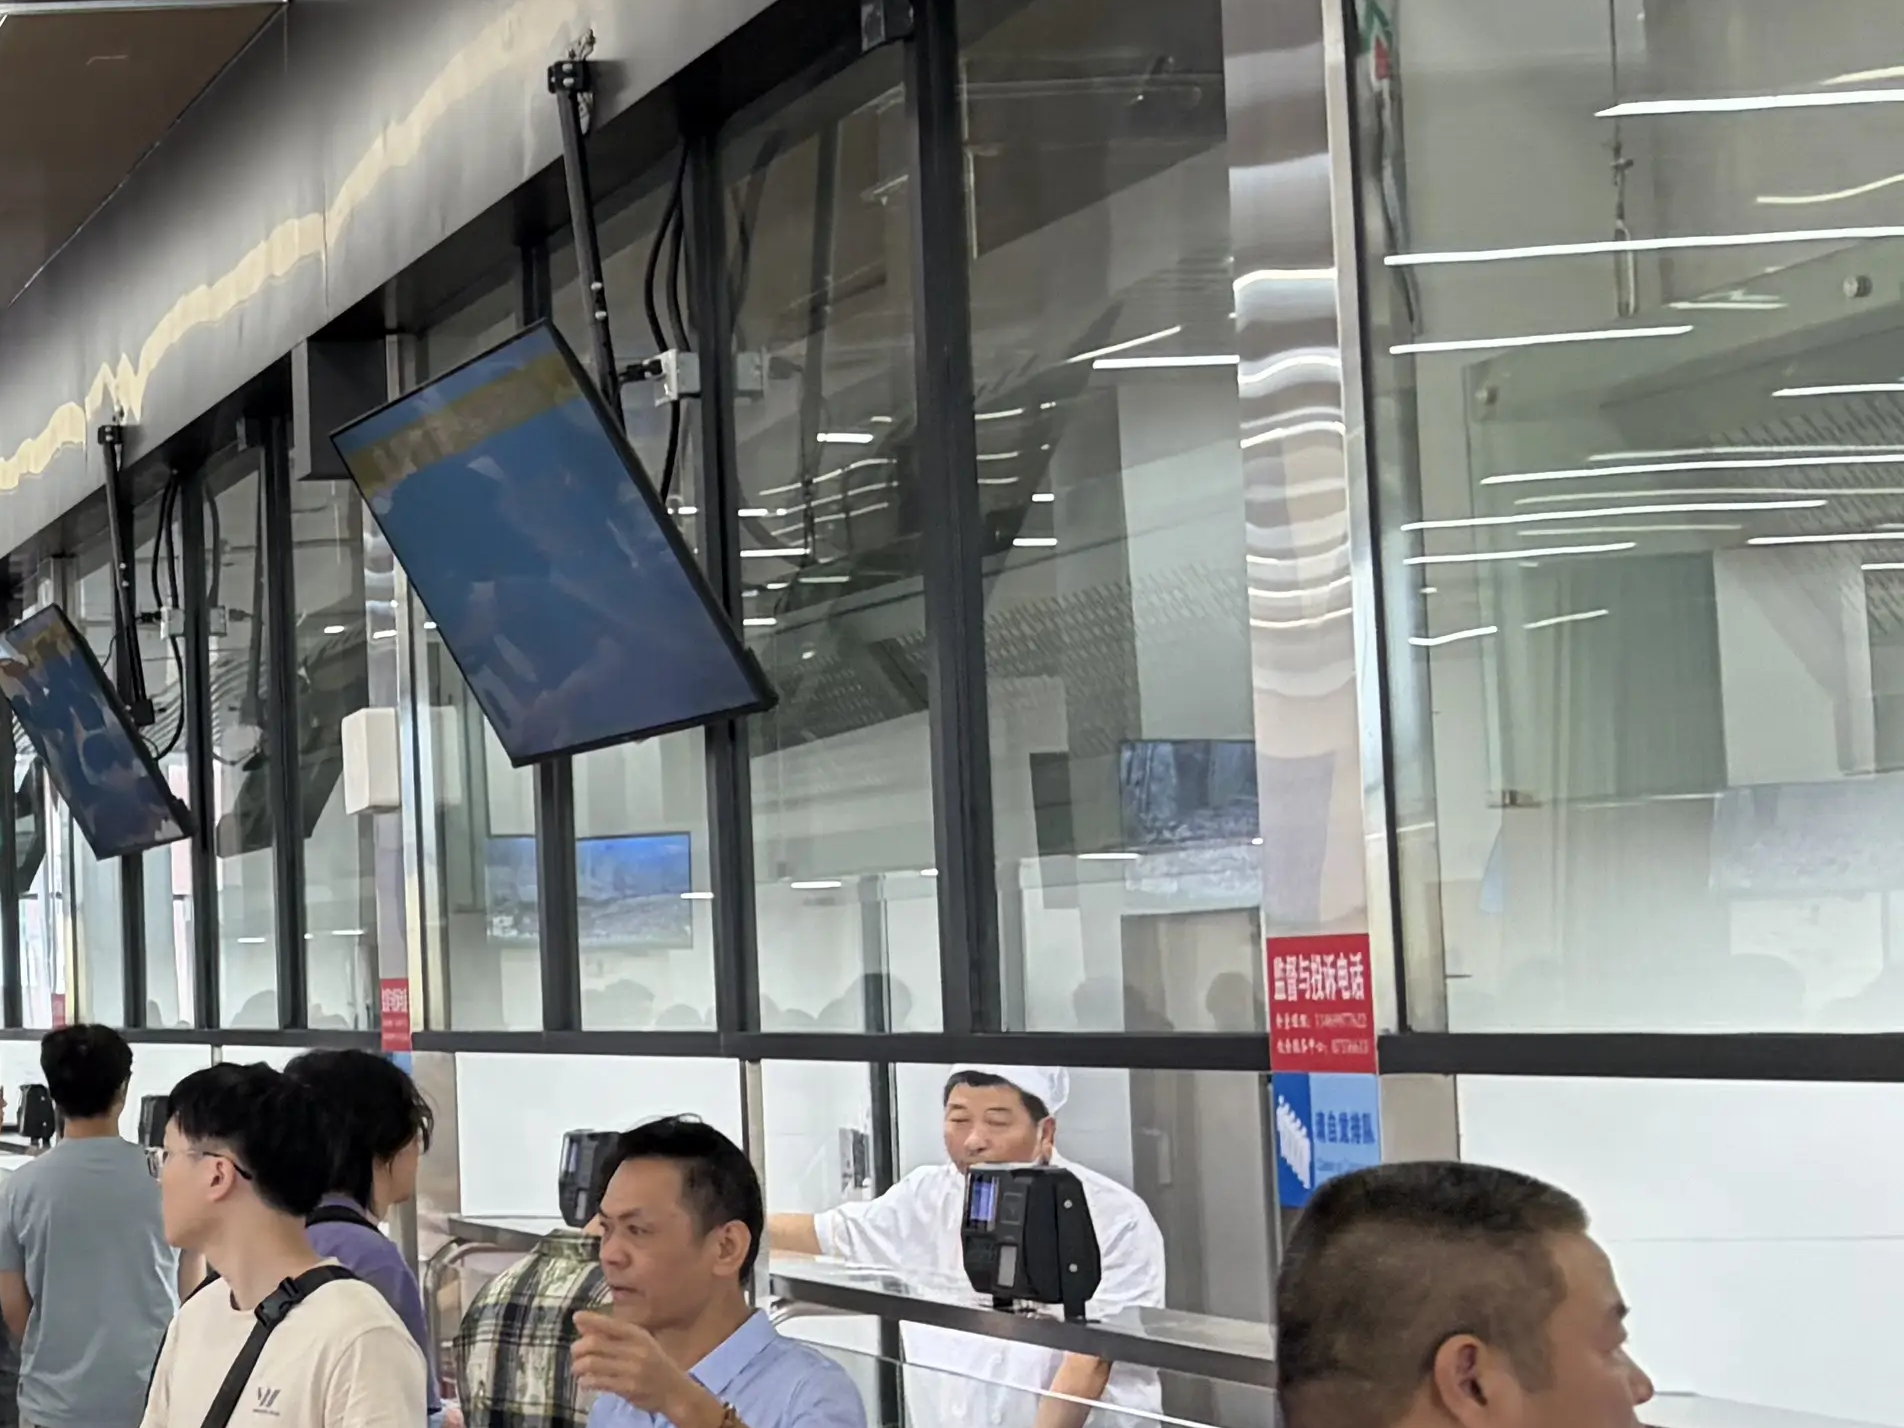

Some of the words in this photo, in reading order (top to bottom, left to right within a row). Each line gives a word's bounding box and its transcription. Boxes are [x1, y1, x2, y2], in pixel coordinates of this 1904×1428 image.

[1273, 952, 1365, 1002] 监督与投诉电话
